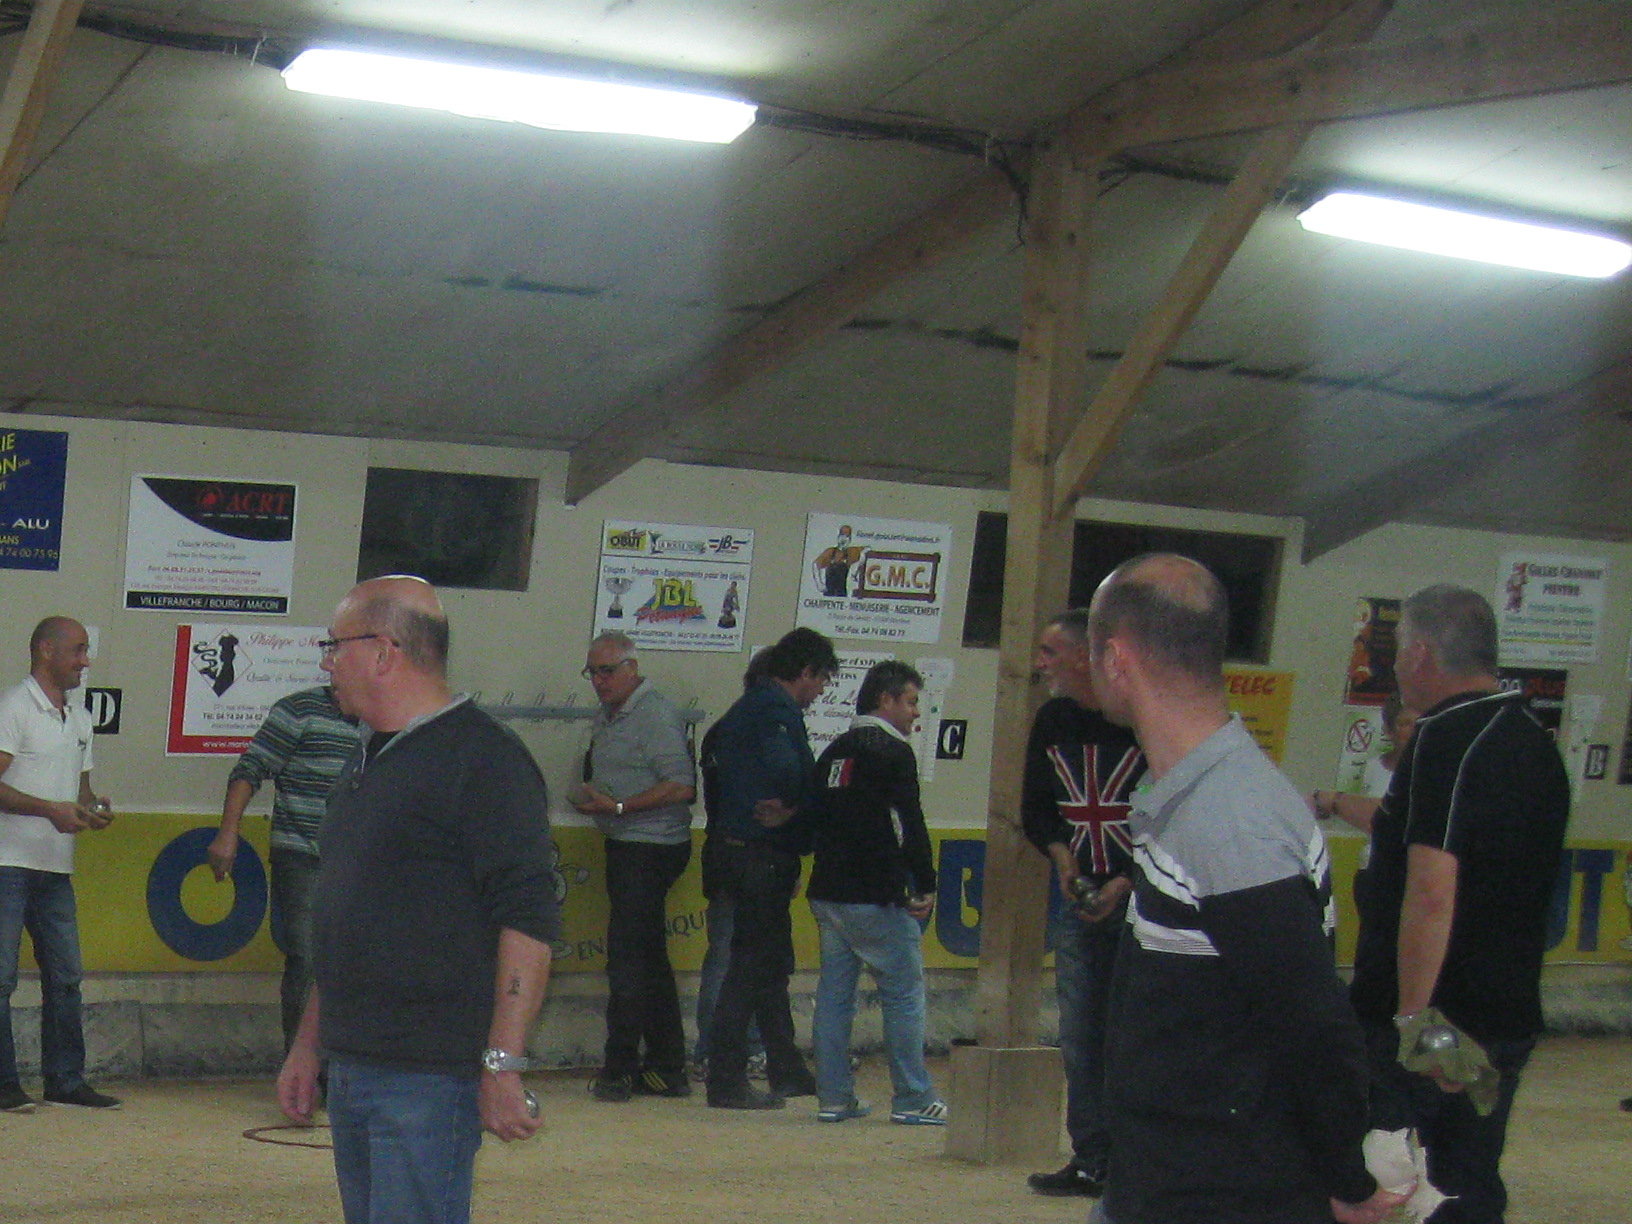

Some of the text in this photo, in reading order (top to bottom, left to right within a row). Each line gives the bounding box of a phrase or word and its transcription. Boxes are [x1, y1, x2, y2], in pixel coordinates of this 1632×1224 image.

[12, 518, 50, 530] ALU
[866, 564, 930, 589] G.M.C.
[140, 596, 202, 608] VILLEFRANCHE
[209, 598, 240, 608] BOURG
[246, 599, 280, 610] MACON
[804, 598, 844, 610] CHARPENTE
[246, 631, 294, 650] Philippe
[1224, 675, 1278, 695] ELEC
[92, 692, 116, 727] D
[942, 725, 962, 754] C
